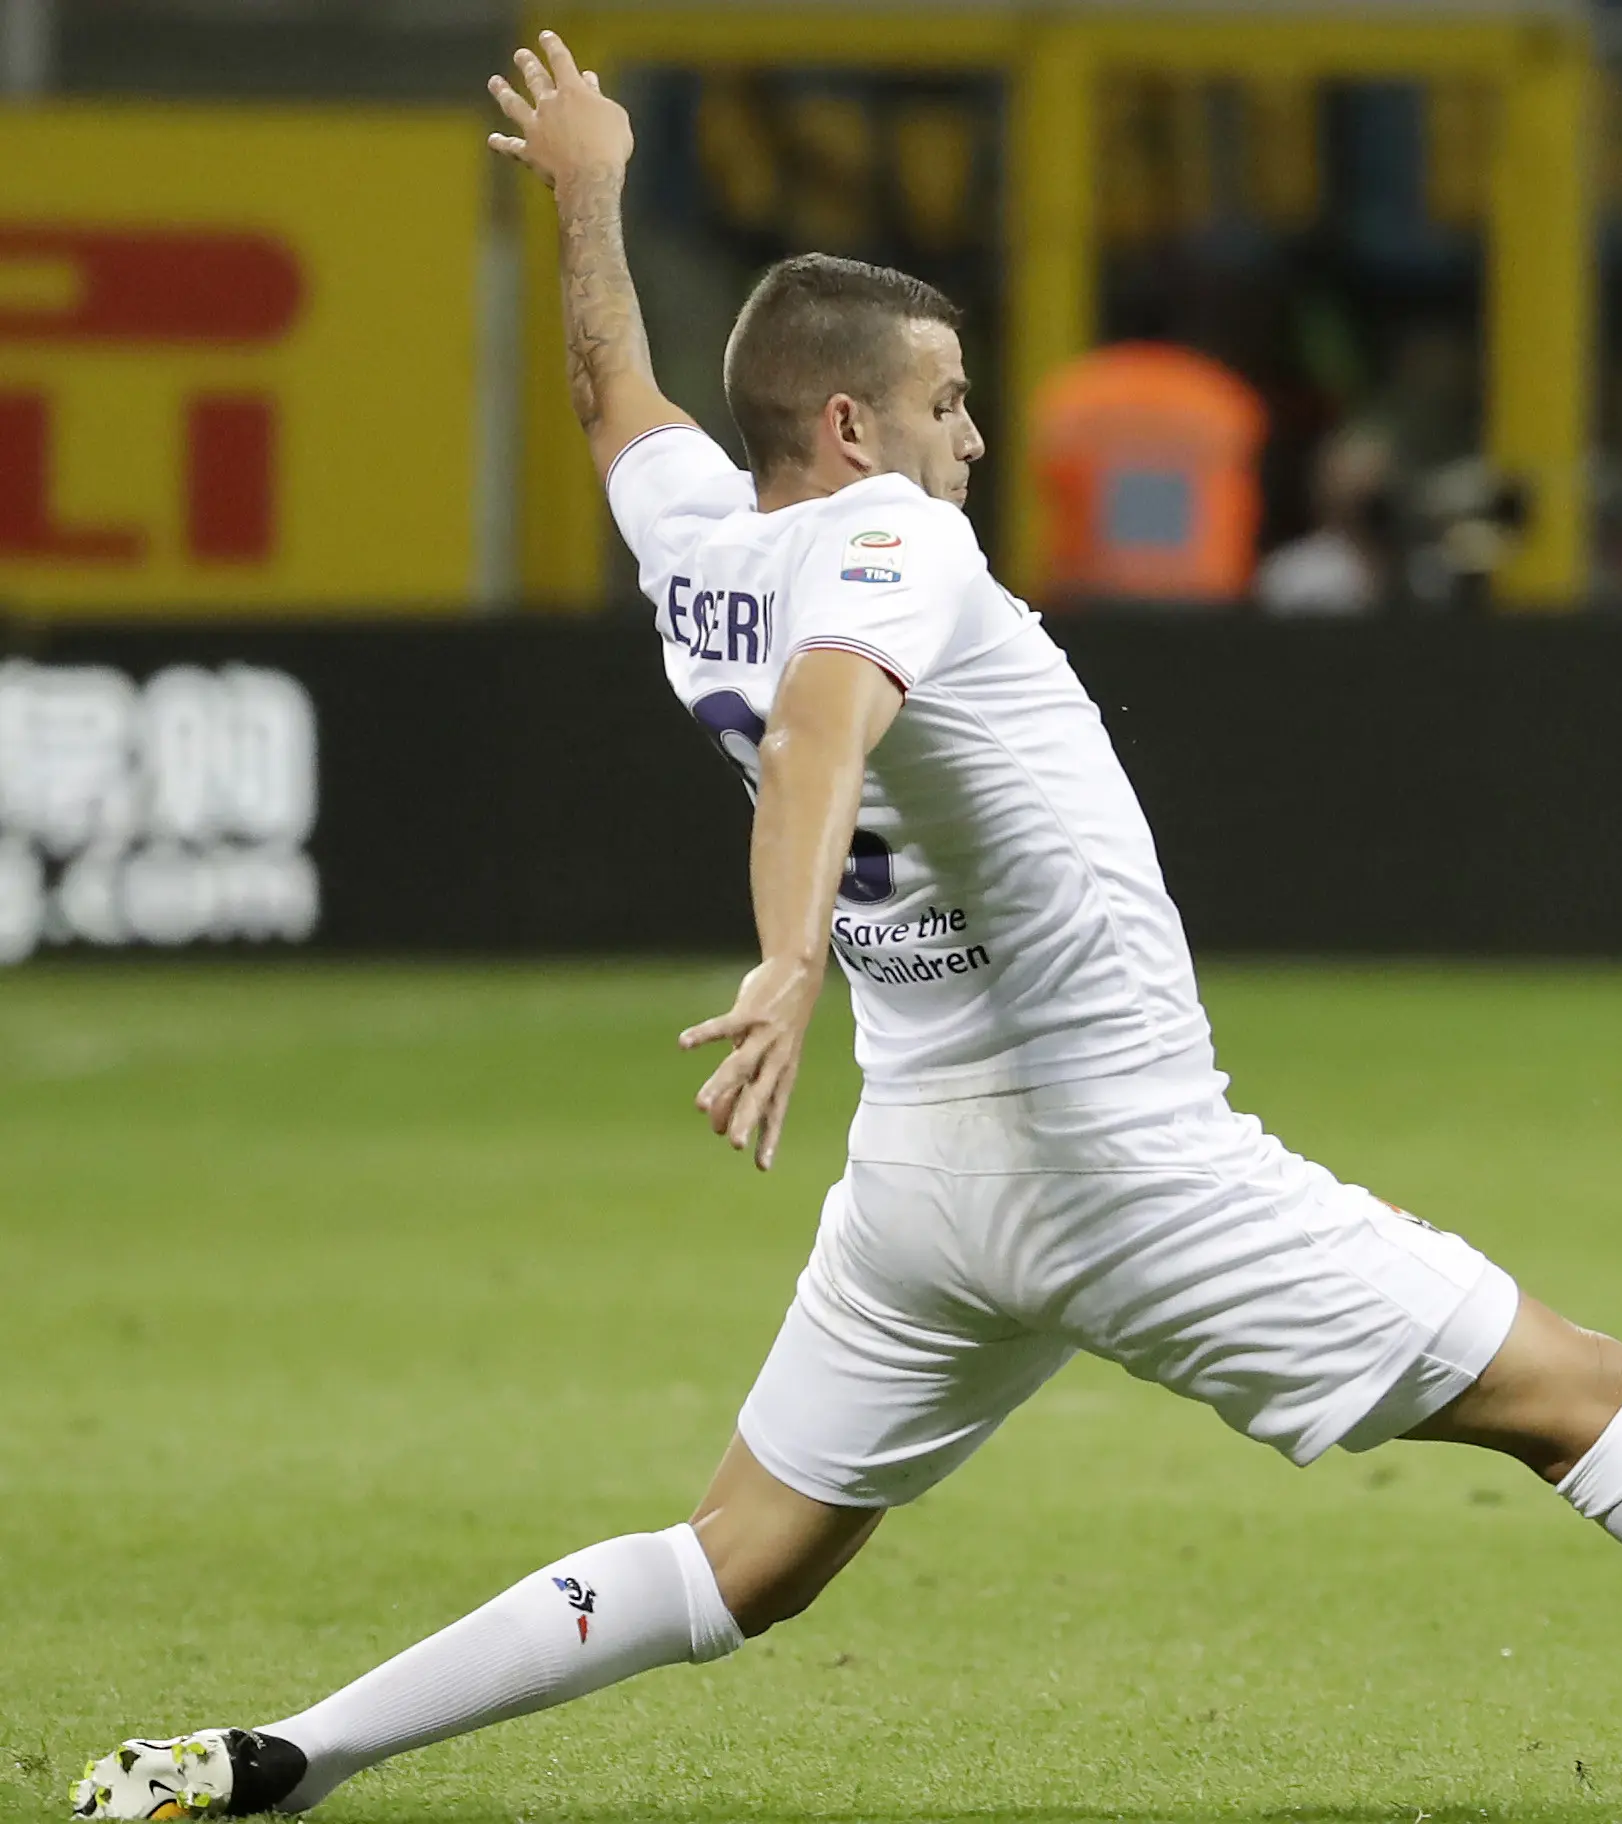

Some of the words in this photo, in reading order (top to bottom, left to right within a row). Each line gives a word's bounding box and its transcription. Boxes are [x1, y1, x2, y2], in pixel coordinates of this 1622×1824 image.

[864, 568, 894, 582] TIM
[834, 916, 910, 948] Save
[916, 906, 967, 939] the
[860, 944, 991, 985] Children
